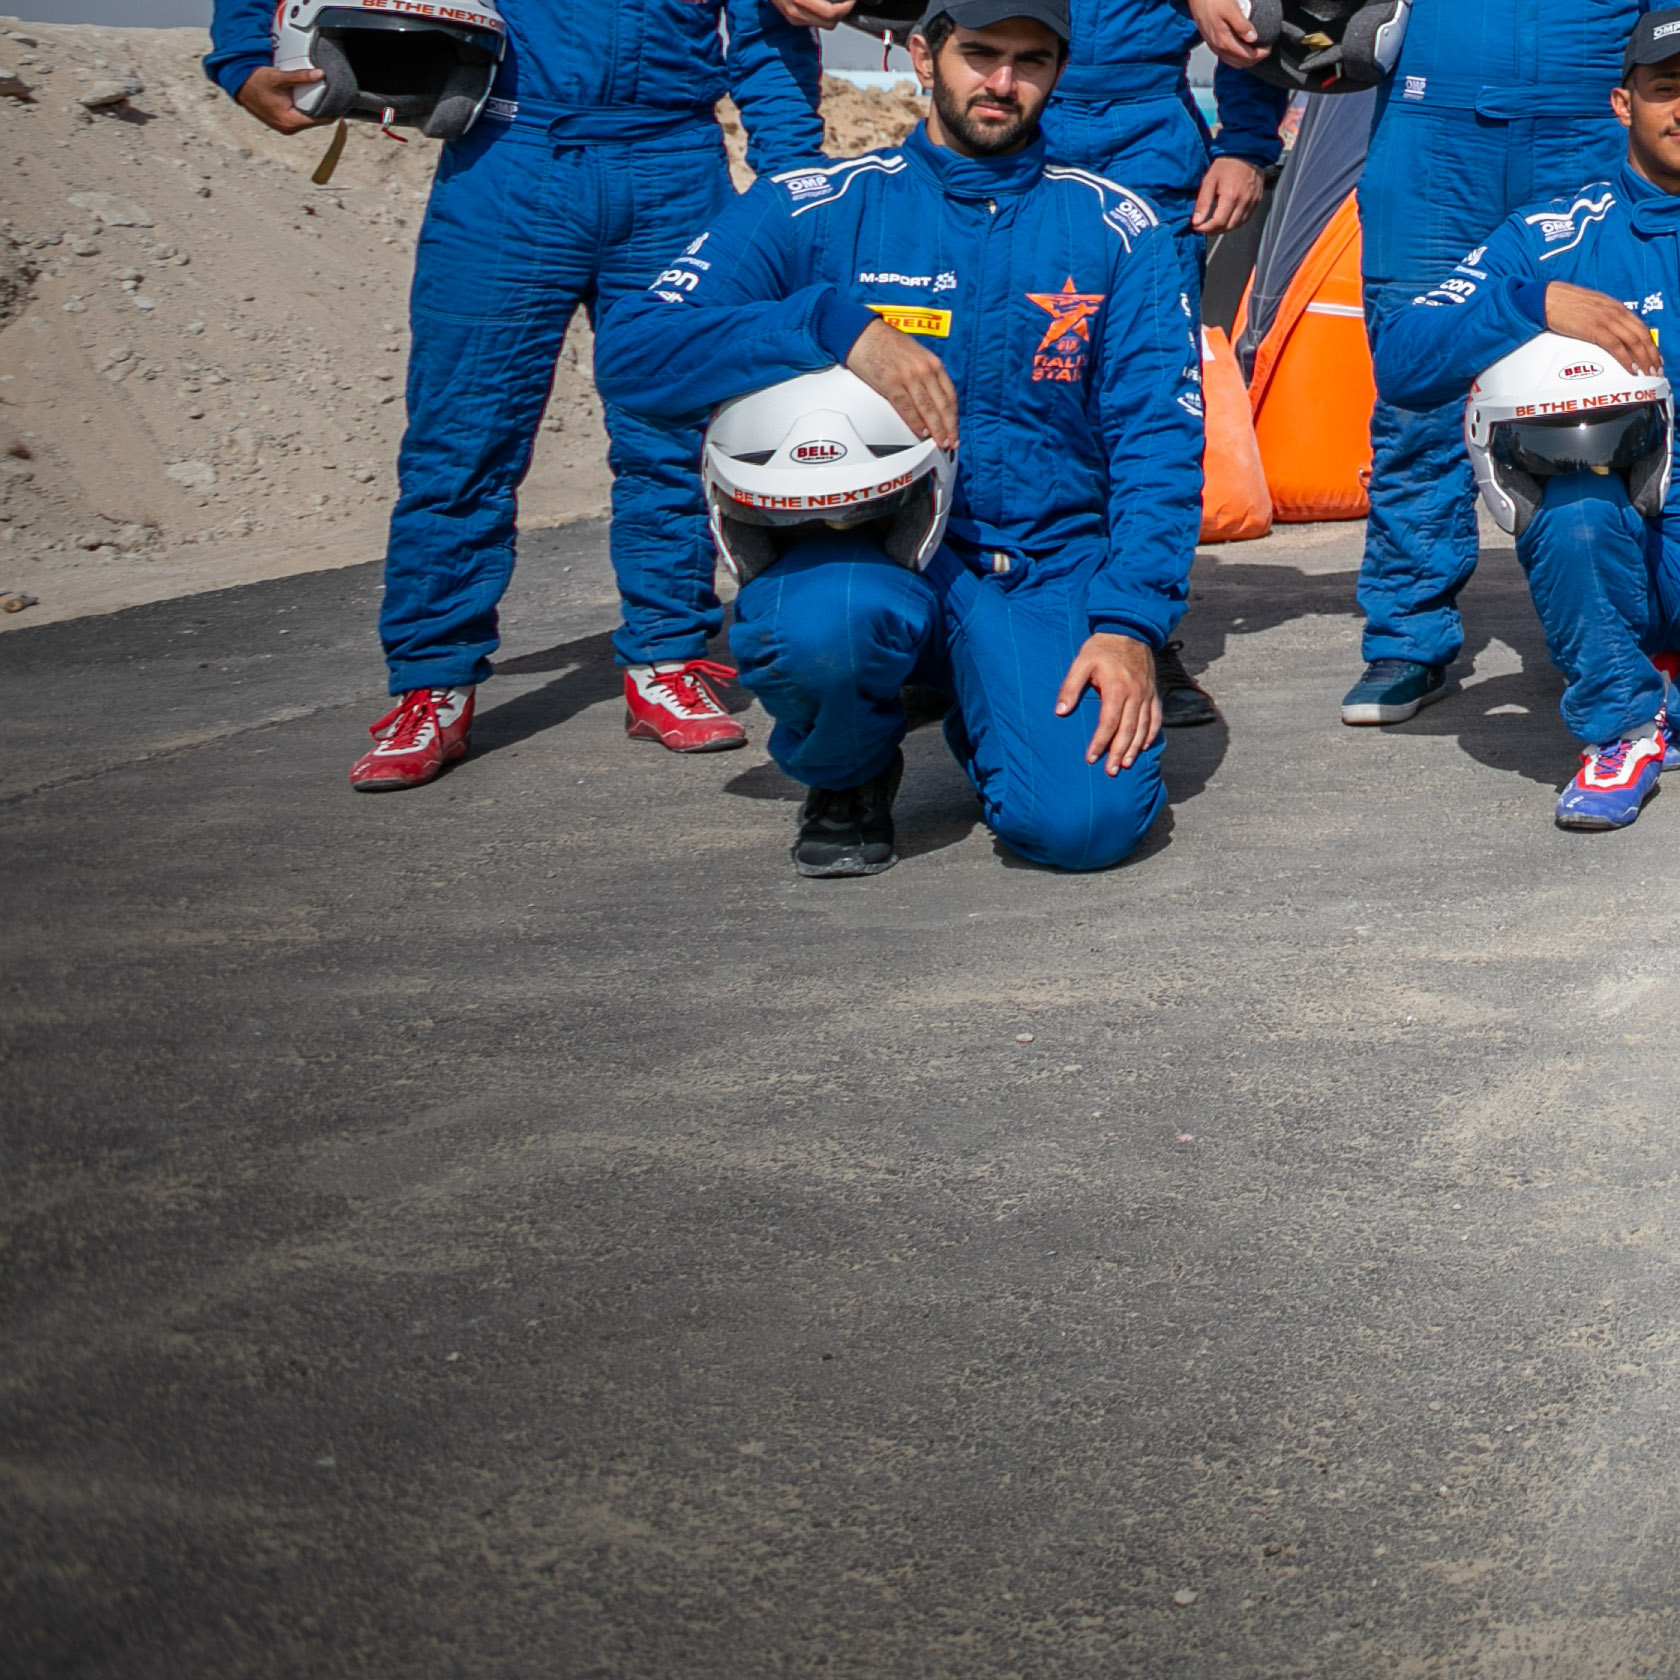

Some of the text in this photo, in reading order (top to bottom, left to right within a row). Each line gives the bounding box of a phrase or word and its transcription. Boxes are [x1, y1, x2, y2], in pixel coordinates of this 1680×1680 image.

[392, 0, 434, 15] THE
[438, 8, 486, 26] NEXT
[1404, 79, 1426, 92] OMP
[788, 176, 828, 191] OMP
[1118, 201, 1148, 230] OMP
[1542, 220, 1575, 233] OMP
[859, 273, 933, 287] M-SPORT
[887, 313, 942, 331] RELLI
[1564, 365, 1597, 376] BELL
[1516, 389, 1657, 417] BE THE NEXT ONE
[797, 445, 839, 458] BELL
[734, 471, 913, 508] BE THE NEXT ONE
